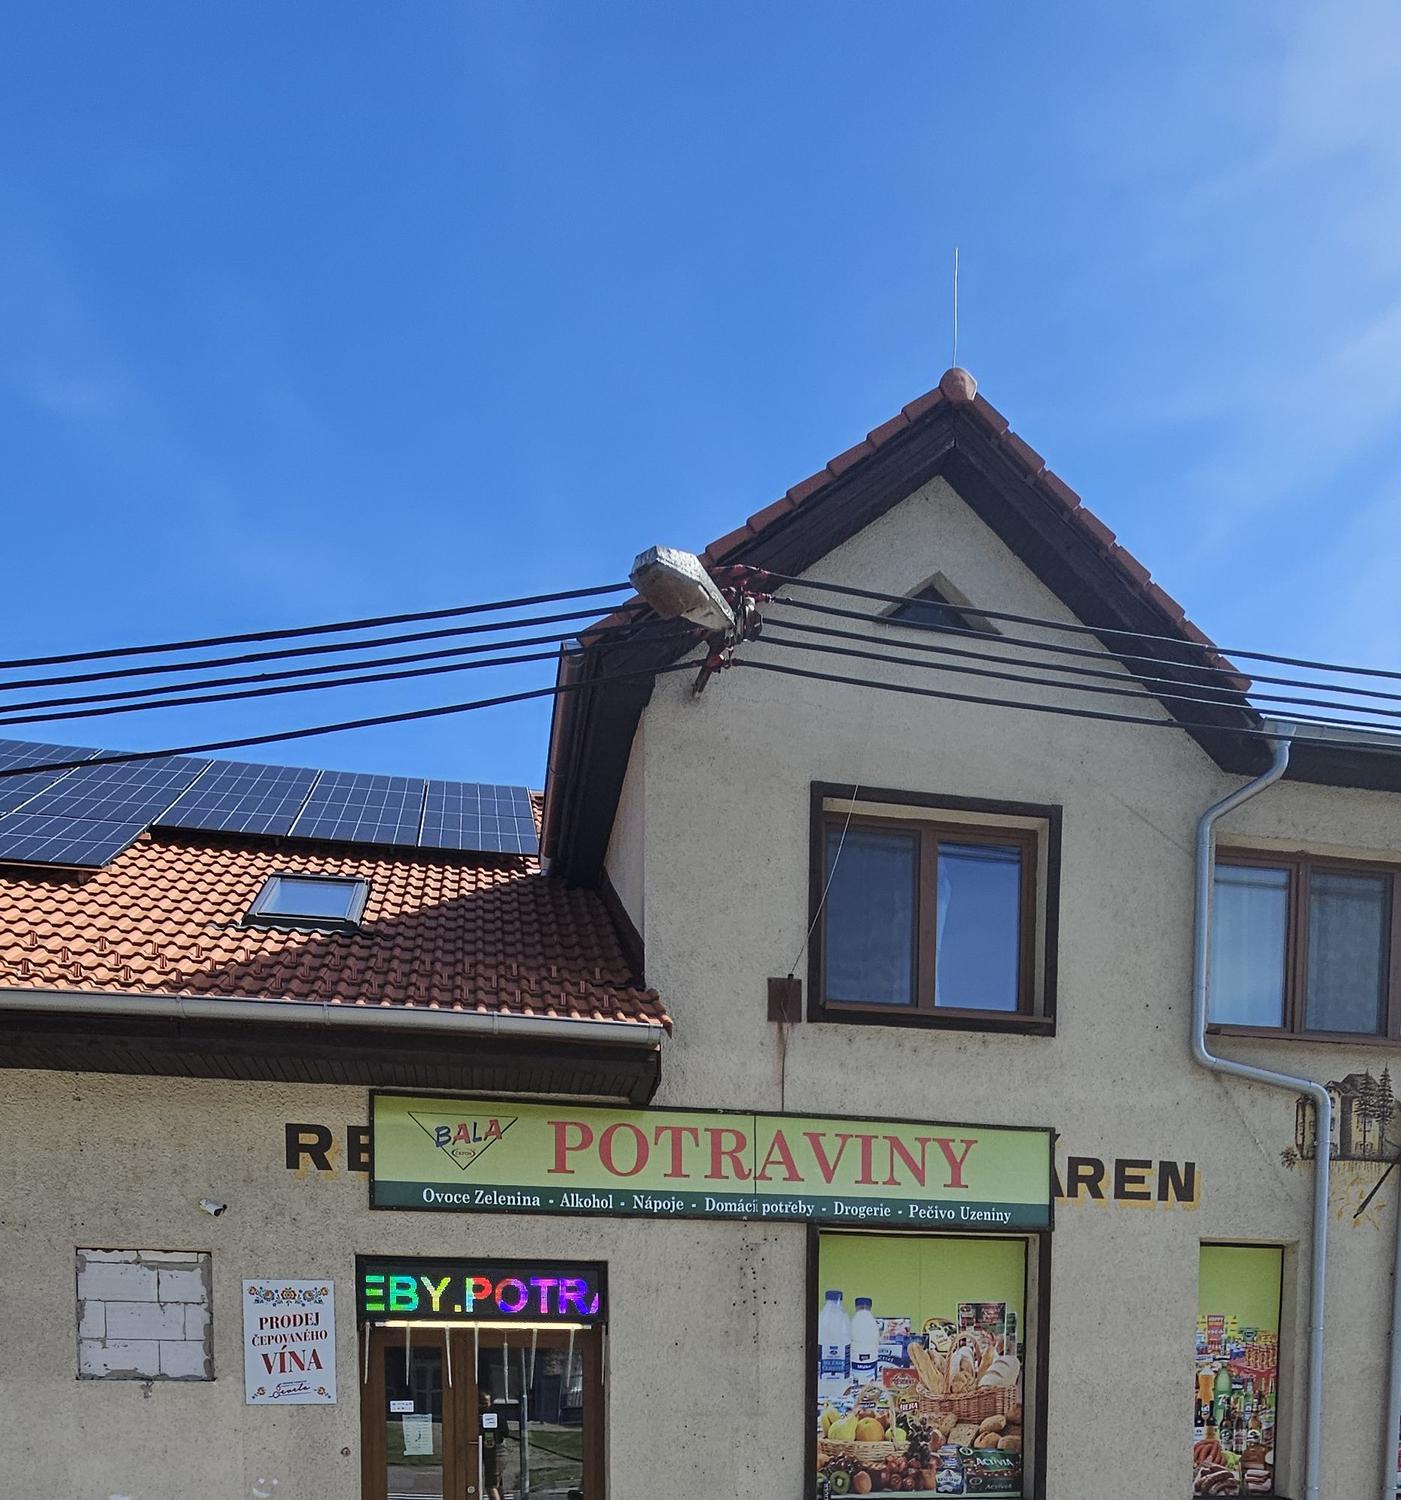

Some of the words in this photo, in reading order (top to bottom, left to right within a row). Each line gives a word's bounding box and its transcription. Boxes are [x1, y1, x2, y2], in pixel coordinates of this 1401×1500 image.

[434, 1118, 503, 1149] BALA
[547, 1119, 979, 1190] POTRAVINY
[422, 1187, 471, 1204] Ovoce
[474, 1189, 541, 1207] Zelenina
[559, 1192, 613, 1209] Alkohol
[632, 1194, 684, 1213] Nápoje
[761, 1199, 815, 1217] potřeby
[833, 1201, 891, 1219] Drogerie
[908, 1204, 956, 1220] Pečivo
[259, 1311, 320, 1331] PRODEJ
[251, 1328, 328, 1347] ČEPOVANÉHO
[261, 1344, 324, 1375] VÍNA
[976, 1457, 1014, 1466] ACTIVIA
